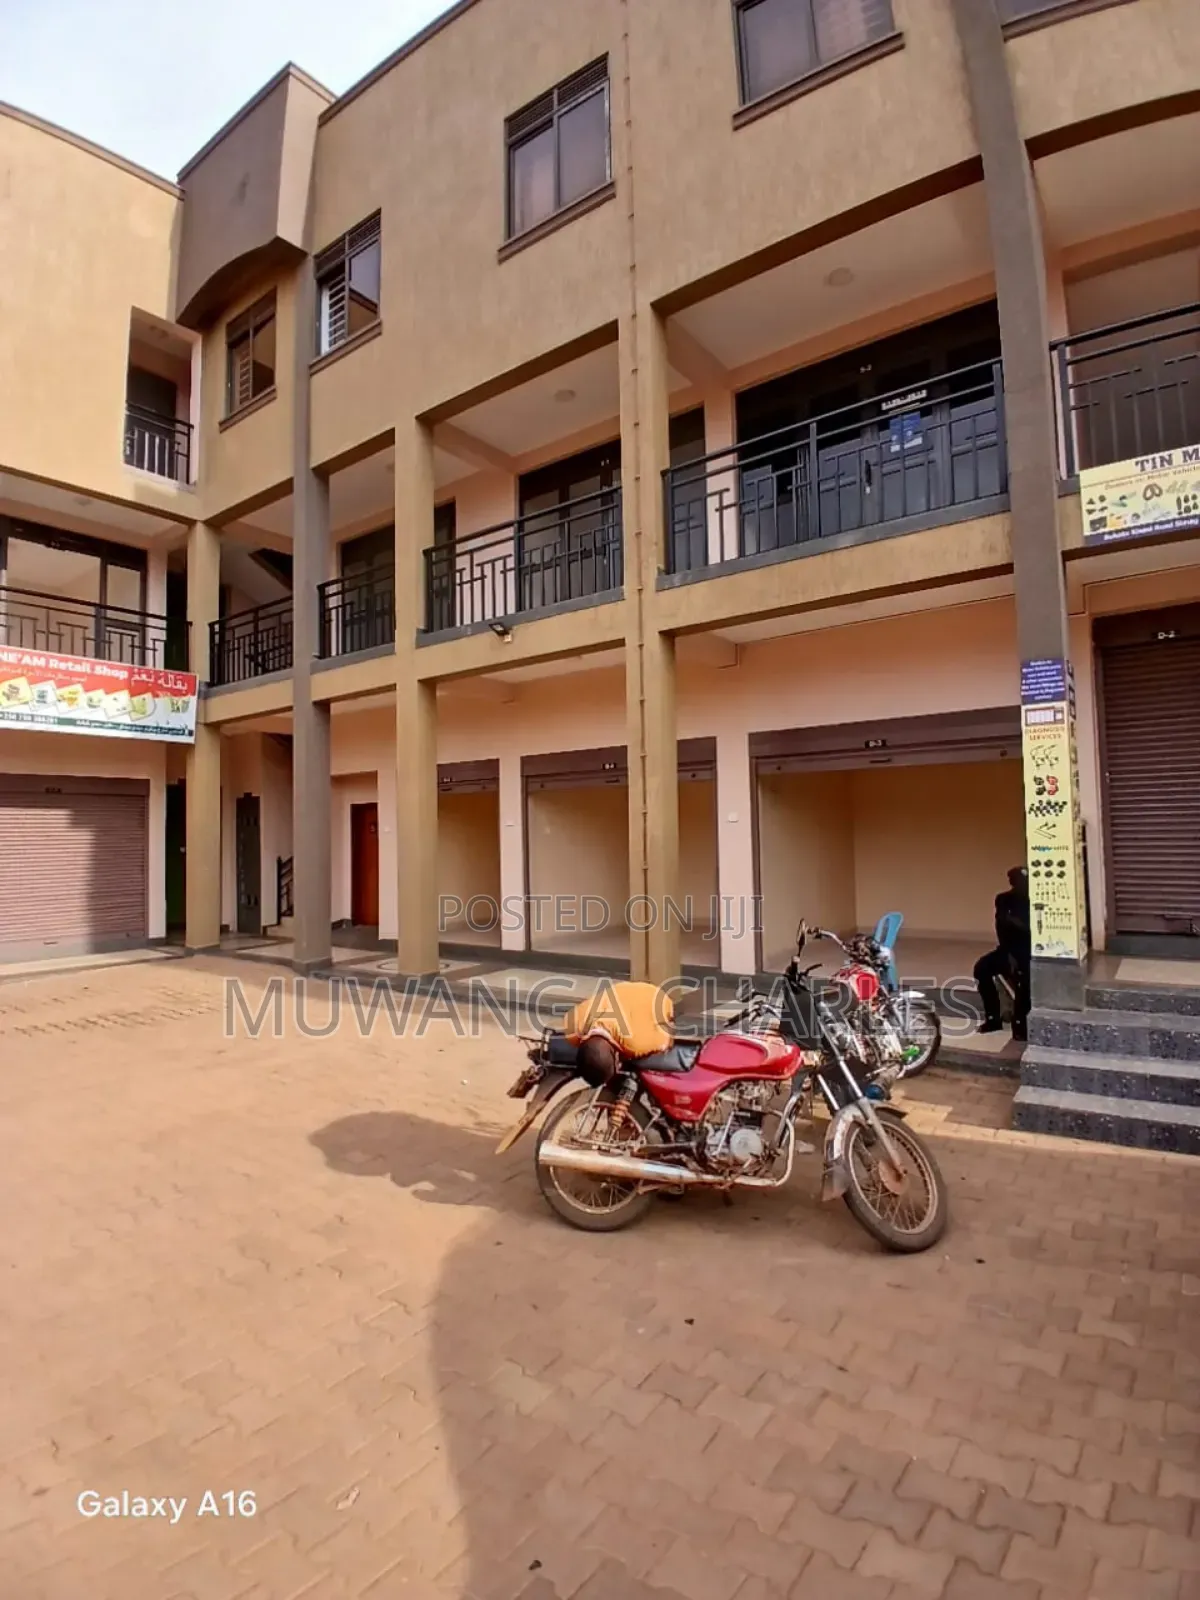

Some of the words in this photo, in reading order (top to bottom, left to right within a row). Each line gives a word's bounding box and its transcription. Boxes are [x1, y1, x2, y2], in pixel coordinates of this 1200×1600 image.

[1134, 453, 1174, 472] TIN
[49, 658, 92, 674] Retail
[94, 664, 130, 681] Shop
[1029, 733, 1062, 741] SERVICES
